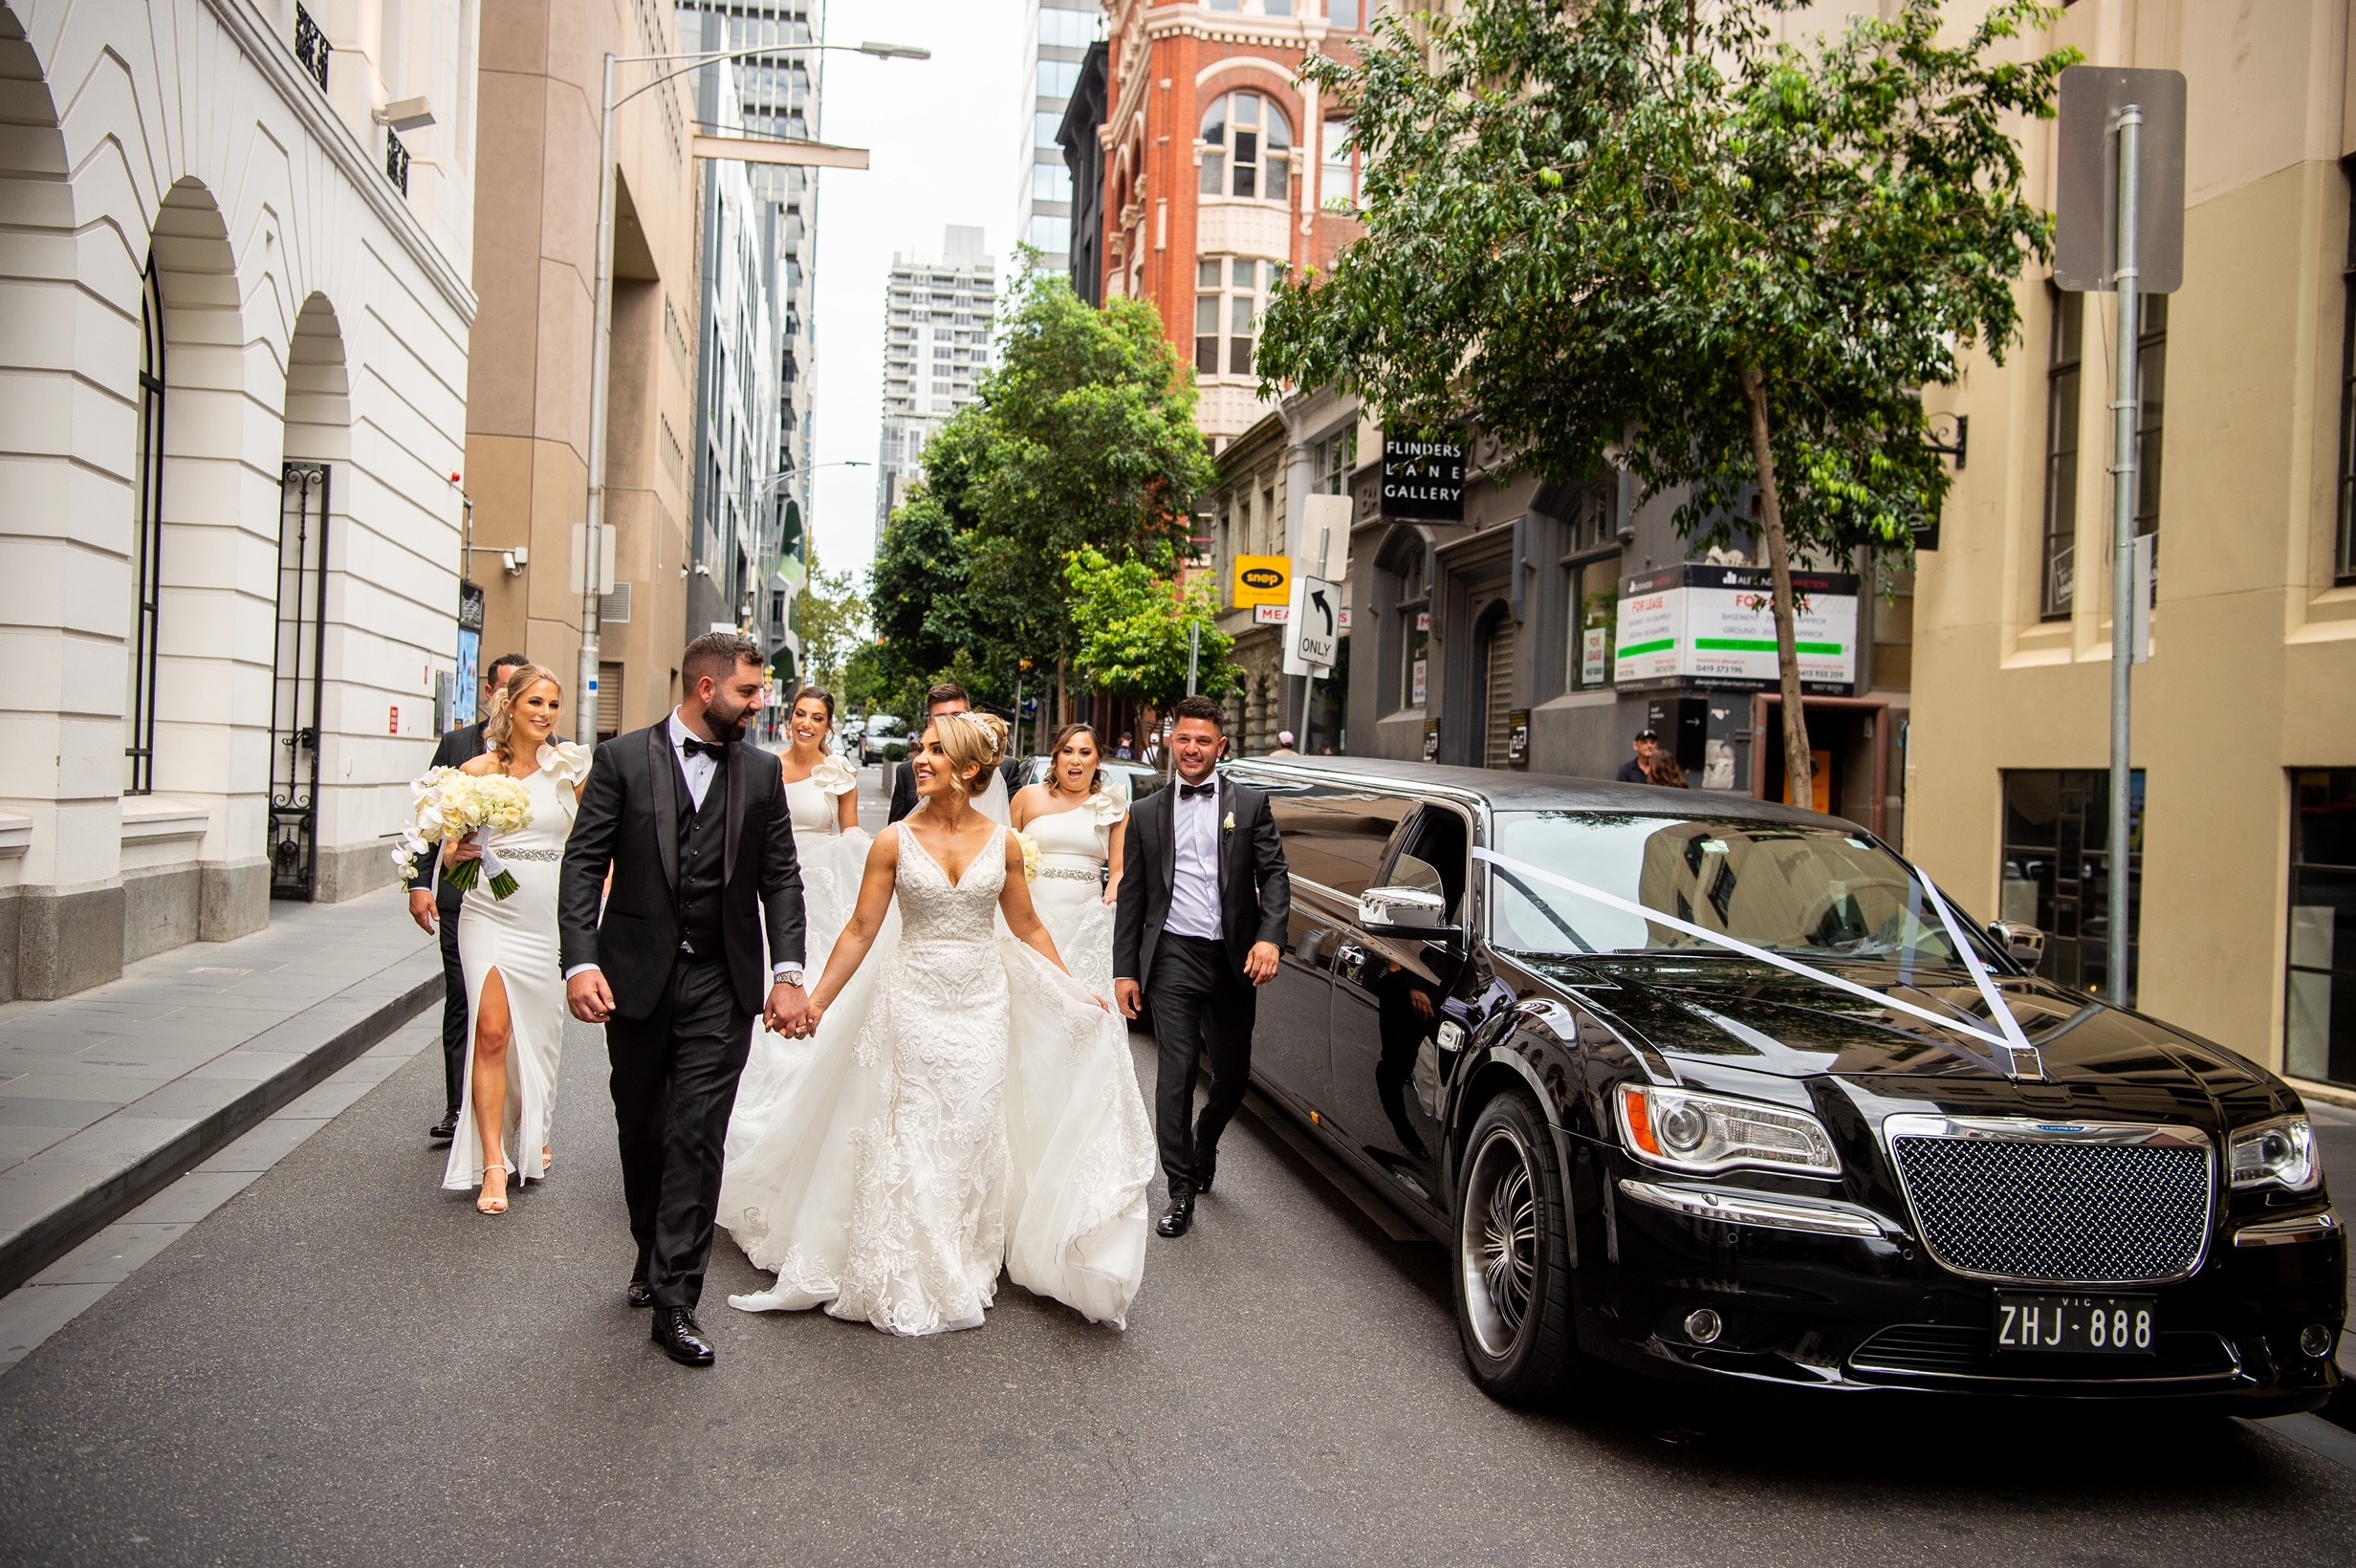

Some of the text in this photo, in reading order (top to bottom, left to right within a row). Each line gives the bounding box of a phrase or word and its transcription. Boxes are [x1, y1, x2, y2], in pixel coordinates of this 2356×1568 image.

[1386, 441, 1461, 457] FLINDERS
[1386, 463, 1460, 479] LANE
[1385, 485, 1461, 501] GALLERY
[1632, 597, 1664, 612] FOR LEASE
[1302, 638, 1331, 657] ONLY
[2062, 1297, 2091, 1307] VIC
